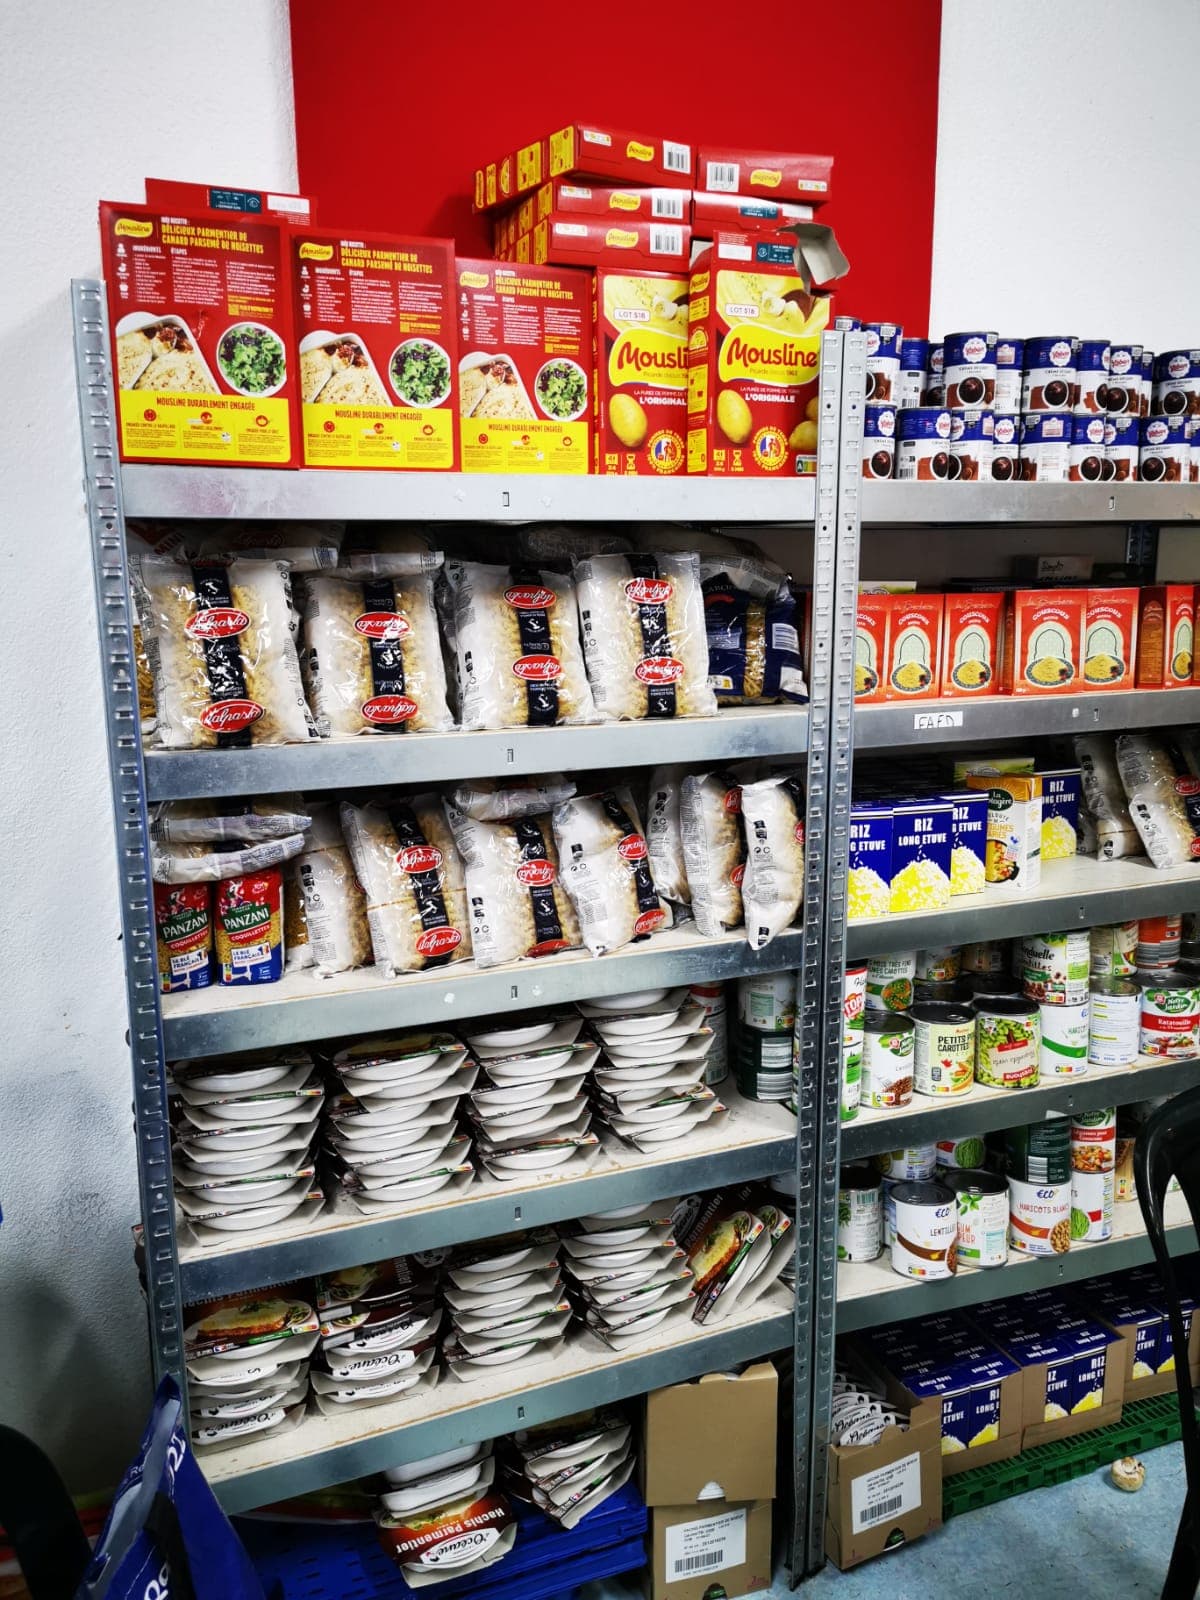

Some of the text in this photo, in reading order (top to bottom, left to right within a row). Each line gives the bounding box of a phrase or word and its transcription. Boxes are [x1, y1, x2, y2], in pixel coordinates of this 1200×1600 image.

[616, 340, 689, 371] Mousli
[726, 336, 818, 368] Mousline
[639, 396, 687, 406] L'ORIGINAL
[744, 392, 796, 403] L'ORIGINALE
[1049, 780, 1065, 793] RIZ
[1055, 792, 1075, 803] ETUVE
[952, 806, 969, 821] RIZ
[850, 824, 871, 839] RIZ
[914, 817, 934, 833] RIZ
[959, 820, 983, 833] ETUVE
[859, 840, 886, 852] ETUVE
[898, 832, 947, 847] LONG ETUVE
[162, 912, 208, 939] PANZANI
[223, 907, 270, 931] PANZANI
[938, 1035, 966, 1044] PETITS
[1090, 1355, 1105, 1370] RIZ
[1078, 1372, 1096, 1383] LONG
[975, 1404, 995, 1415] LONG
[464, 1507, 506, 1528] Hachis
[395, 1521, 464, 1554] Parmentier
